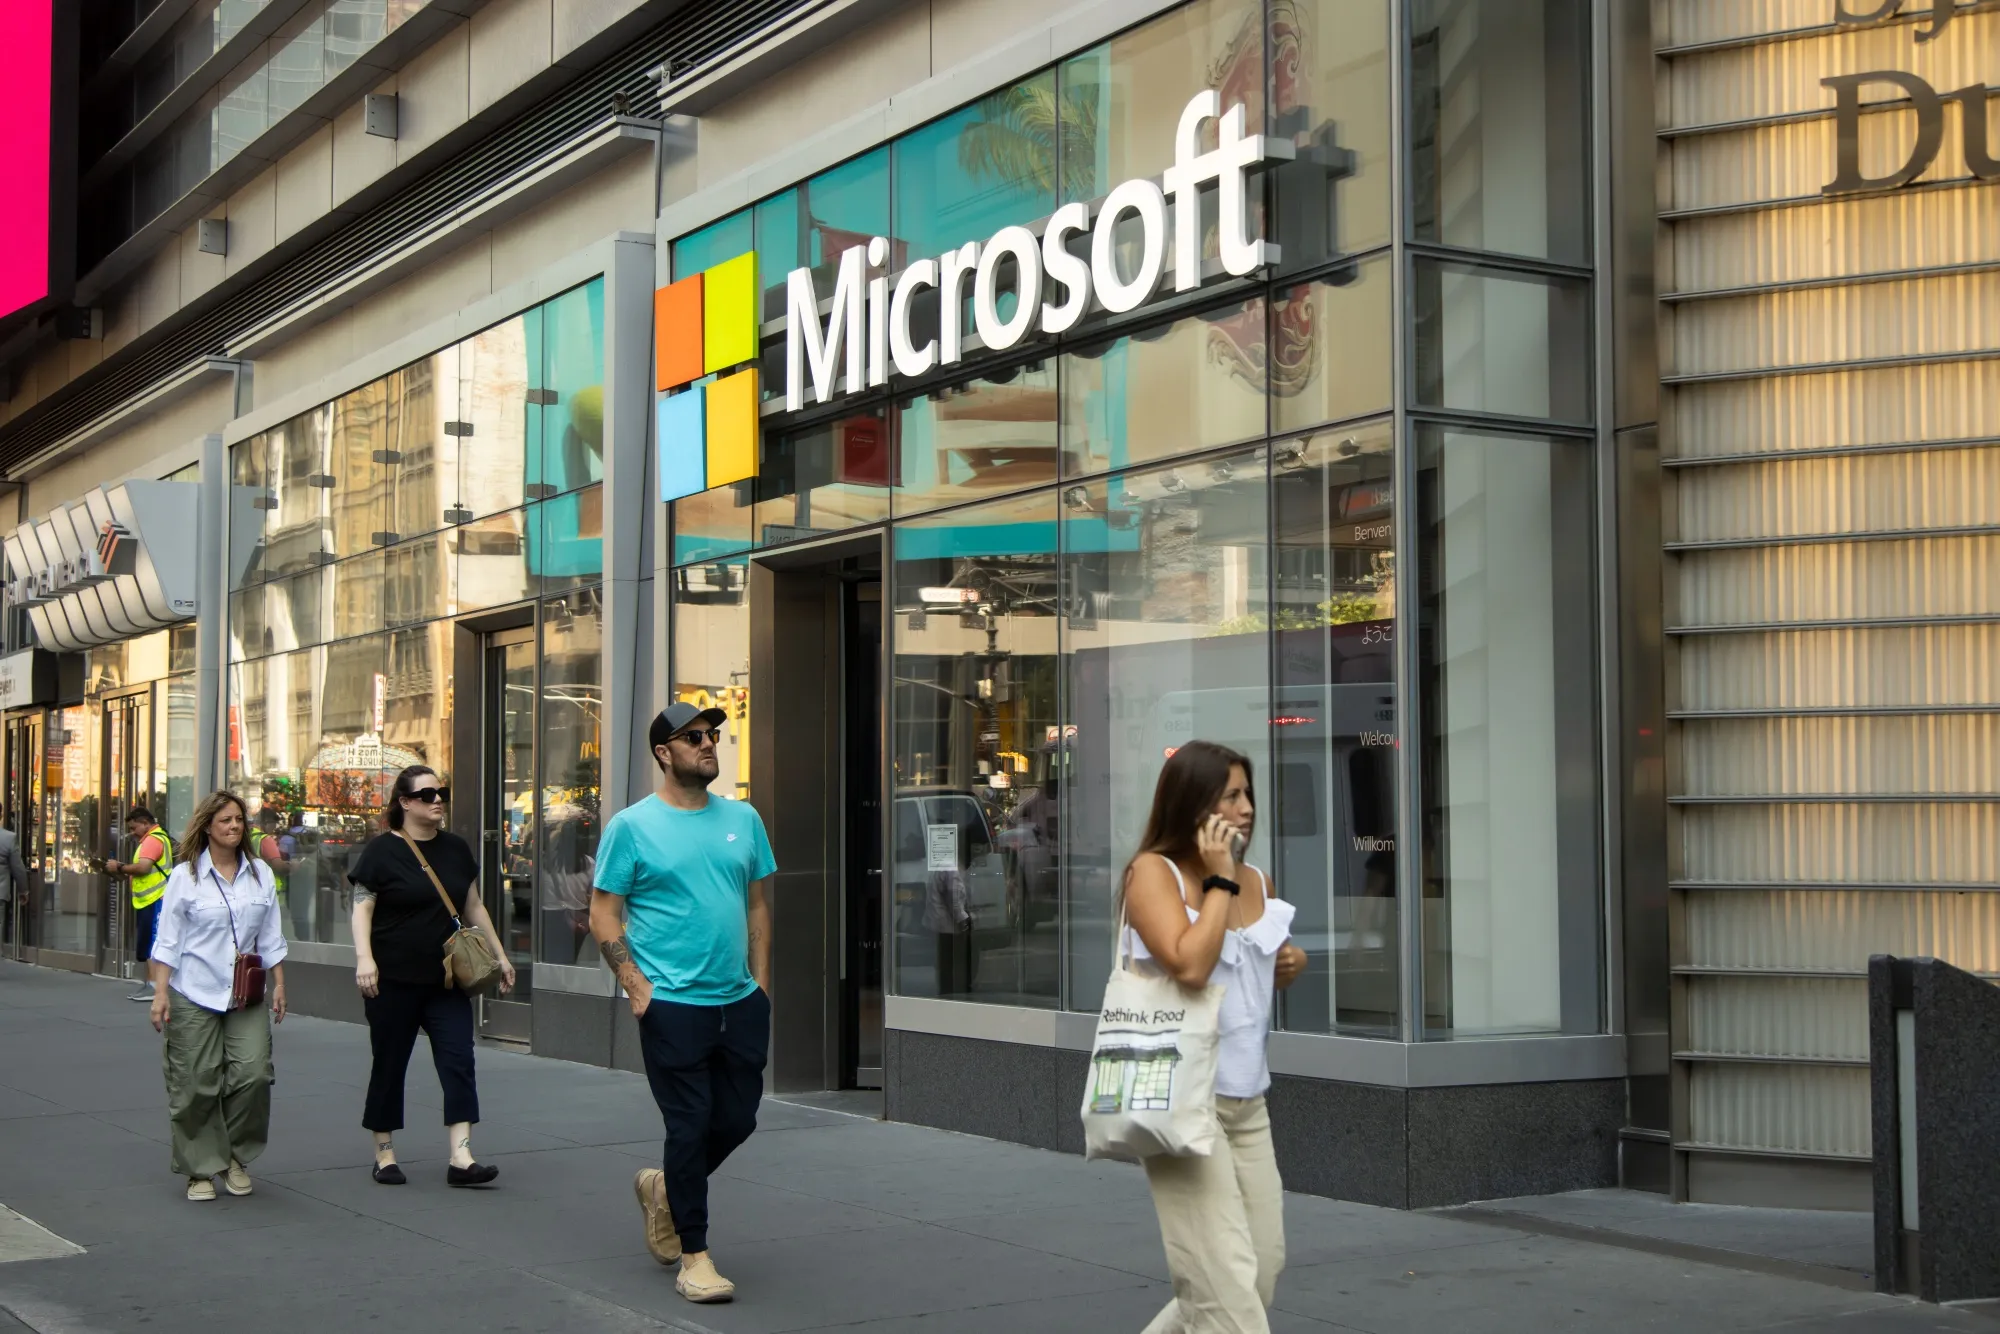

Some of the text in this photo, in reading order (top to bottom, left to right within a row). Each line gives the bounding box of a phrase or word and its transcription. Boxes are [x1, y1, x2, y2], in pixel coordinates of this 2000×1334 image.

[786, 90, 1267, 411] Microsoft
[1354, 525, 1392, 541] Benven
[1359, 730, 1394, 747] Welco
[1352, 835, 1395, 851] Willkom
[1103, 1008, 1186, 1024] Rethink Food
